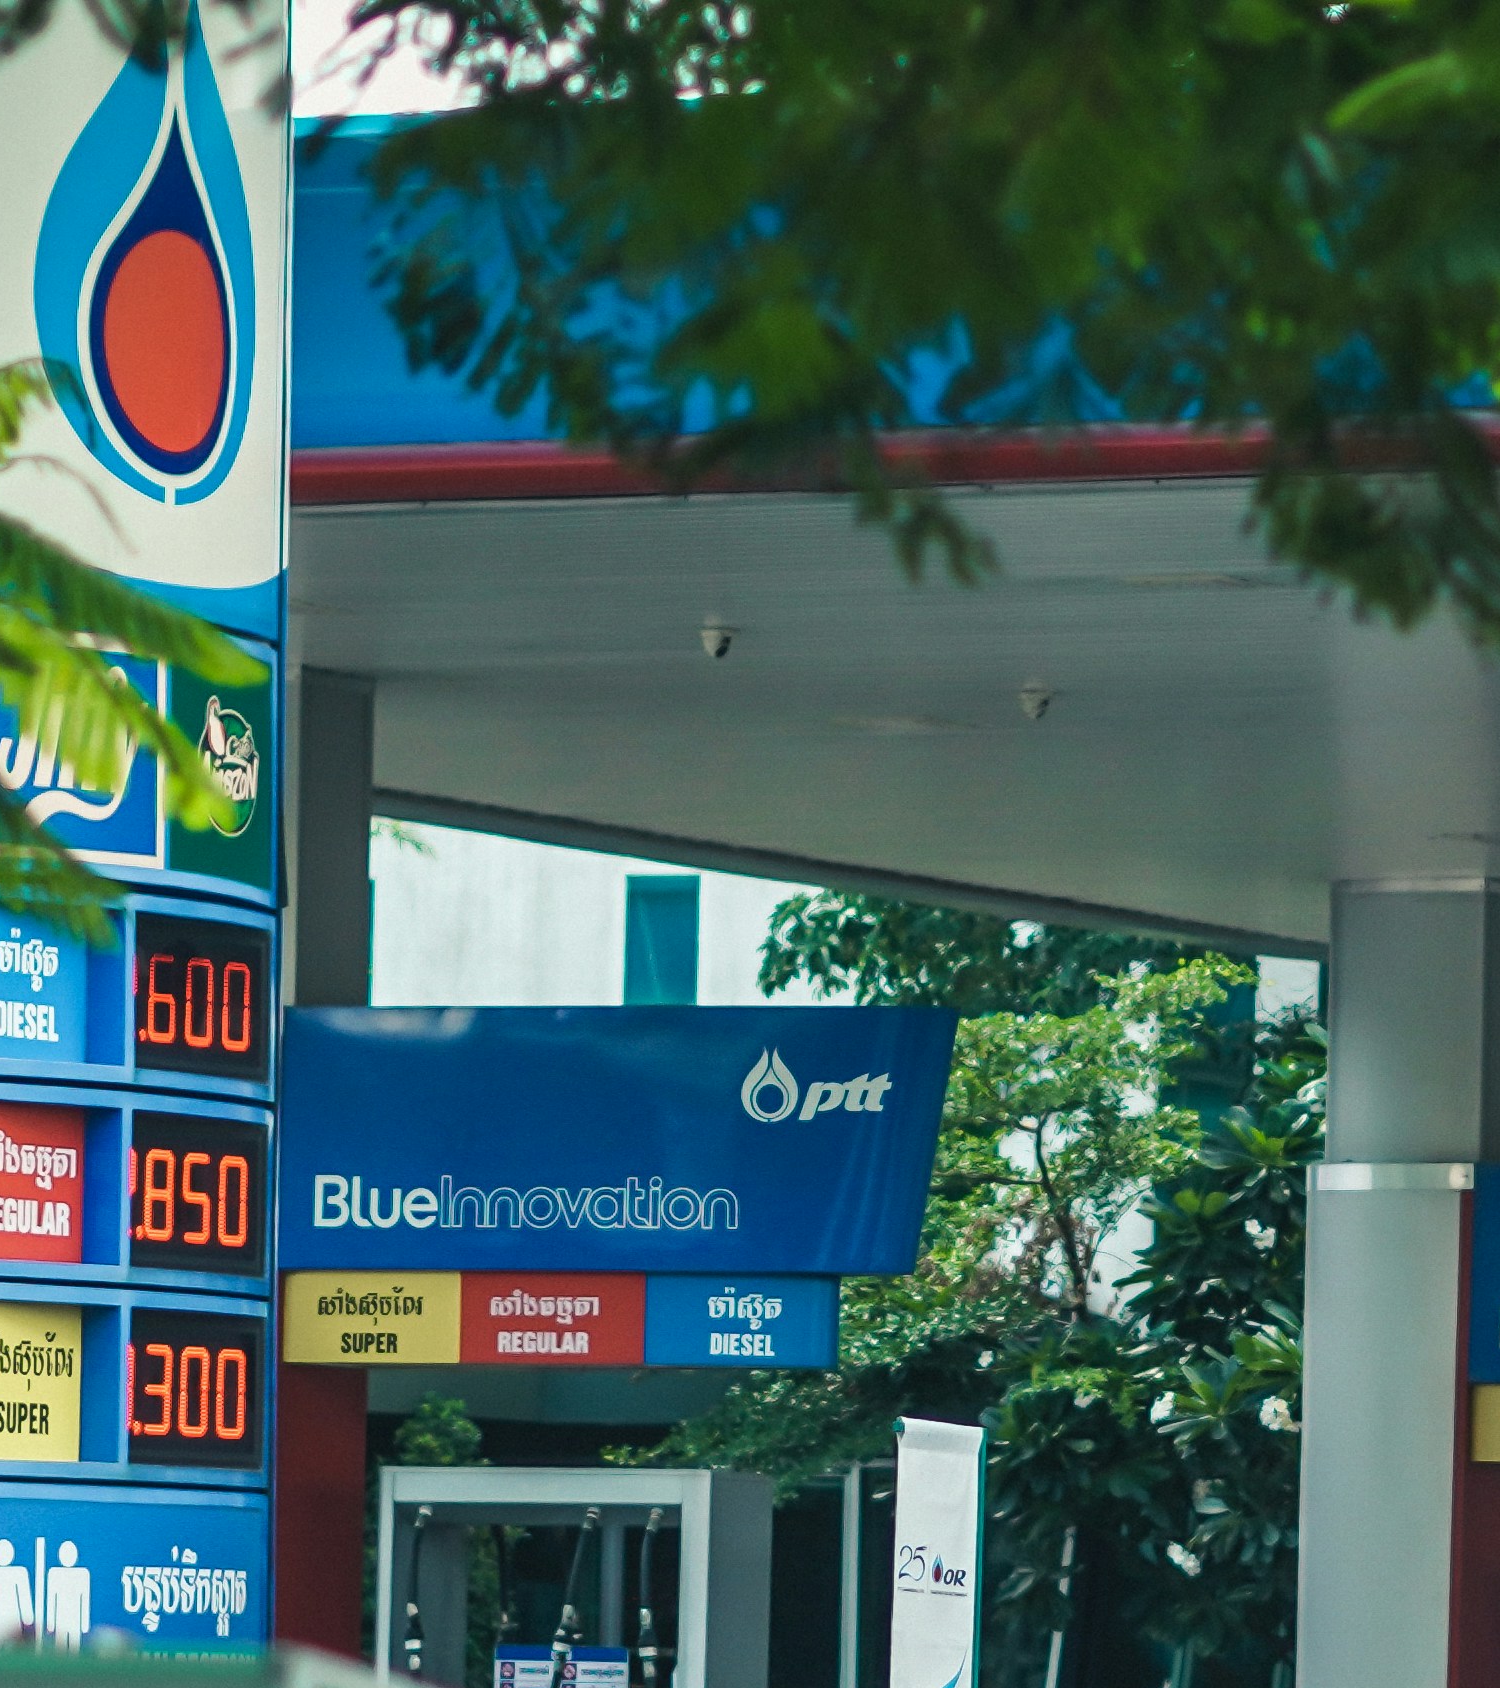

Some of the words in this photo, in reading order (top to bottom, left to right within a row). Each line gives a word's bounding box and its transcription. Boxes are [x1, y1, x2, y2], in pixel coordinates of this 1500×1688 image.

[133, 953, 252, 1052] ,600
[798, 1072, 893, 1121] ptt
[128, 1146, 249, 1248] ,850
[313, 1174, 738, 1230] BlueInnovation
[341, 1332, 398, 1354] SUPER
[497, 1331, 590, 1355] REGULAR
[709, 1332, 775, 1356] DIESEL
[126, 1343, 248, 1440] ,300
[899, 1545, 927, 1581] 25
[944, 1569, 967, 1587] OR
